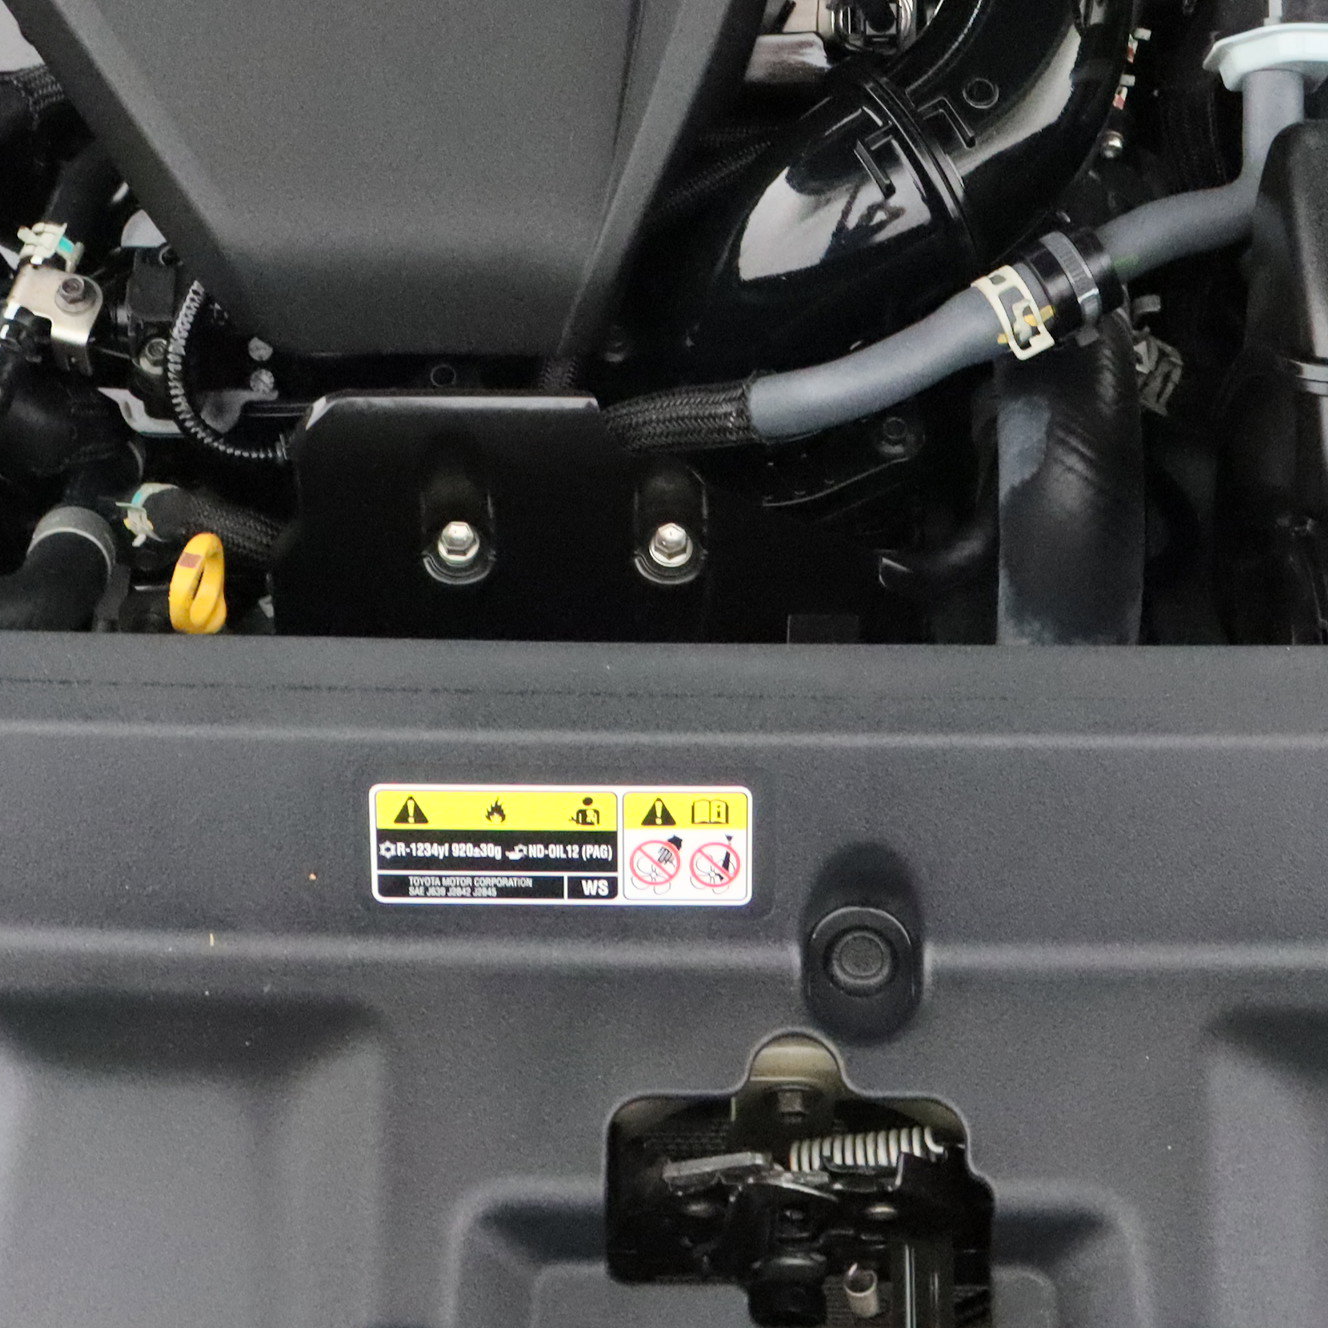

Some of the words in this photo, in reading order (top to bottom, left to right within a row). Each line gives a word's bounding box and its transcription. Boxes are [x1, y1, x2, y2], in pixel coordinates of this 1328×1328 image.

[396, 842, 449, 860] R-1234yf
[528, 844, 579, 859] ND-OIL12
[582, 844, 613, 862] (PAG)
[409, 876, 441, 887] TOYOTA
[442, 876, 473, 887] MOTOR
[474, 877, 533, 888] CORPORATION
[582, 880, 609, 896] WS
